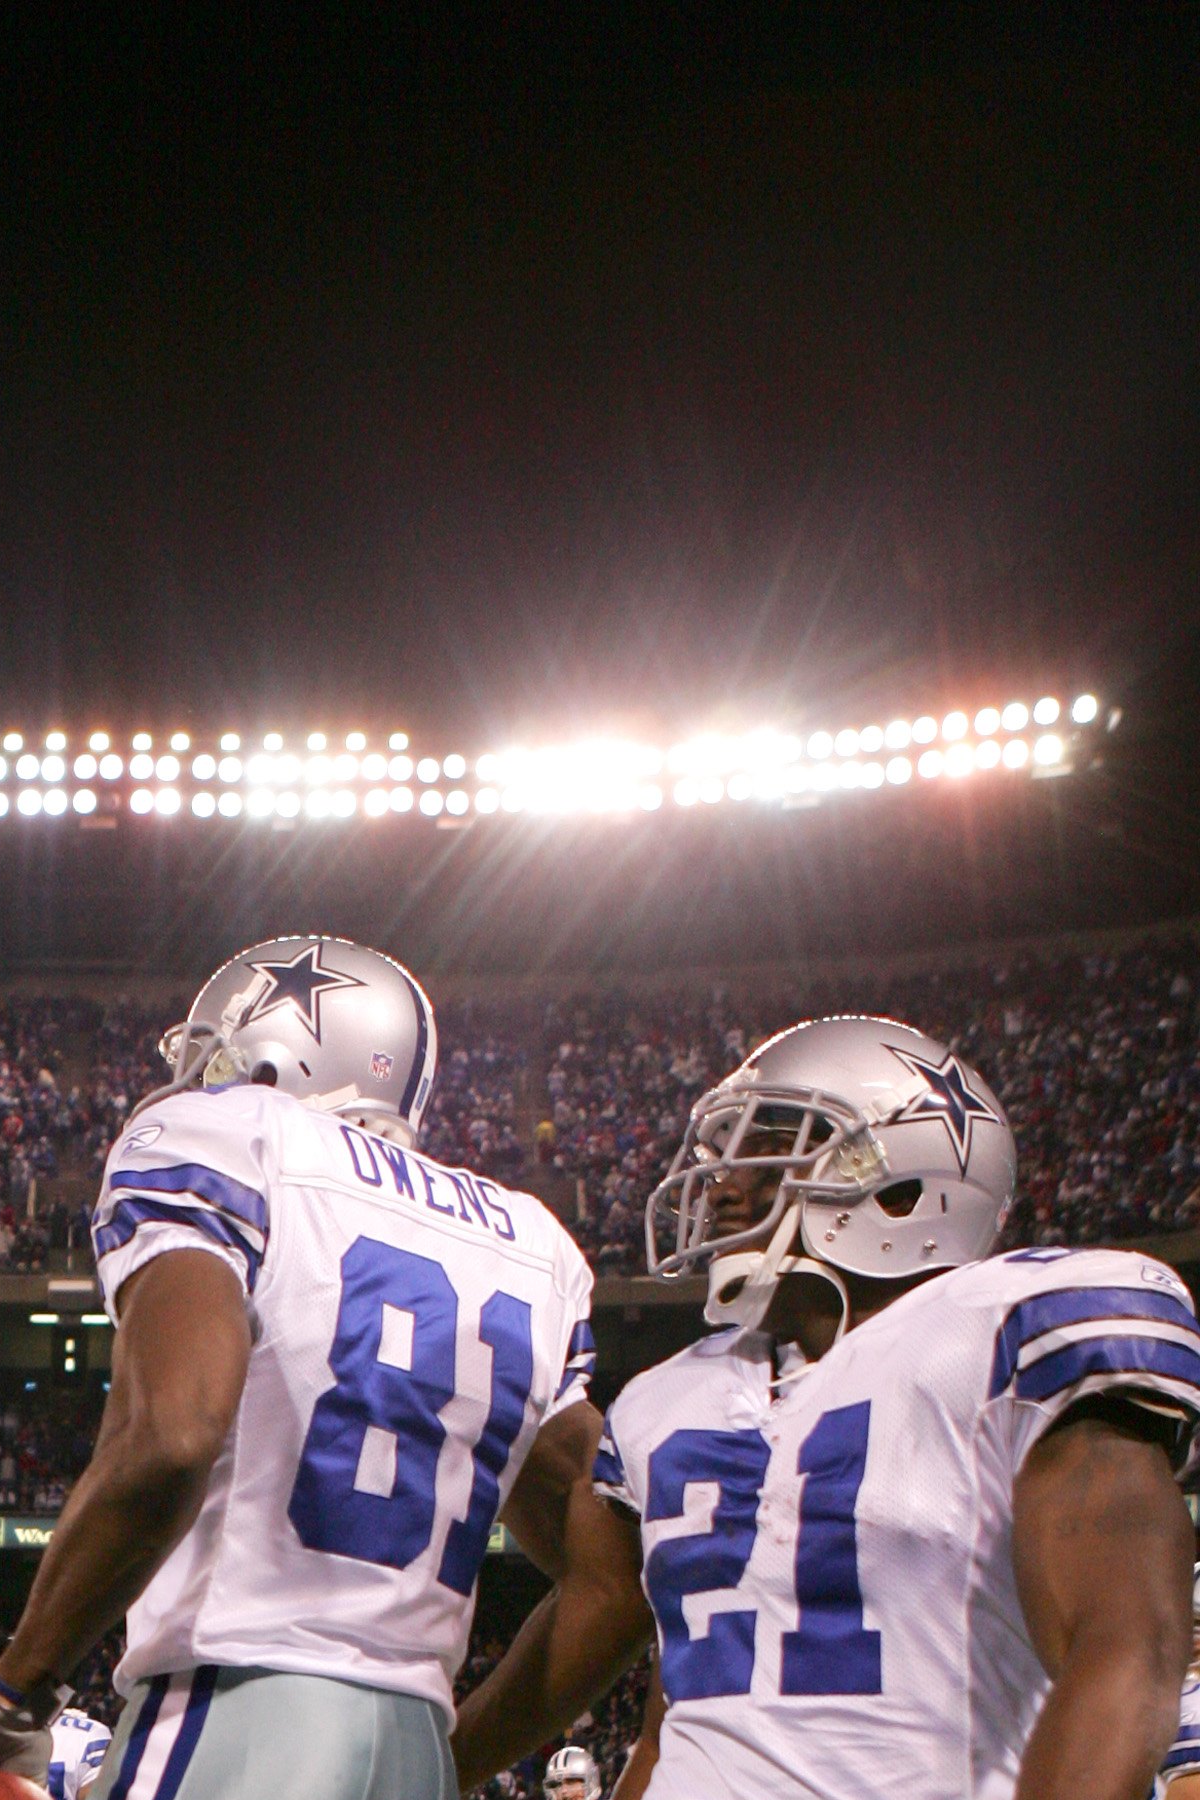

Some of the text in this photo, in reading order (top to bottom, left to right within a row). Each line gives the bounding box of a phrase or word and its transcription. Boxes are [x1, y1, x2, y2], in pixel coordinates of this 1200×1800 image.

[339, 1124, 516, 1241] OWENS
[286, 1233, 533, 1597] 81
[643, 1399, 882, 1704] 21
